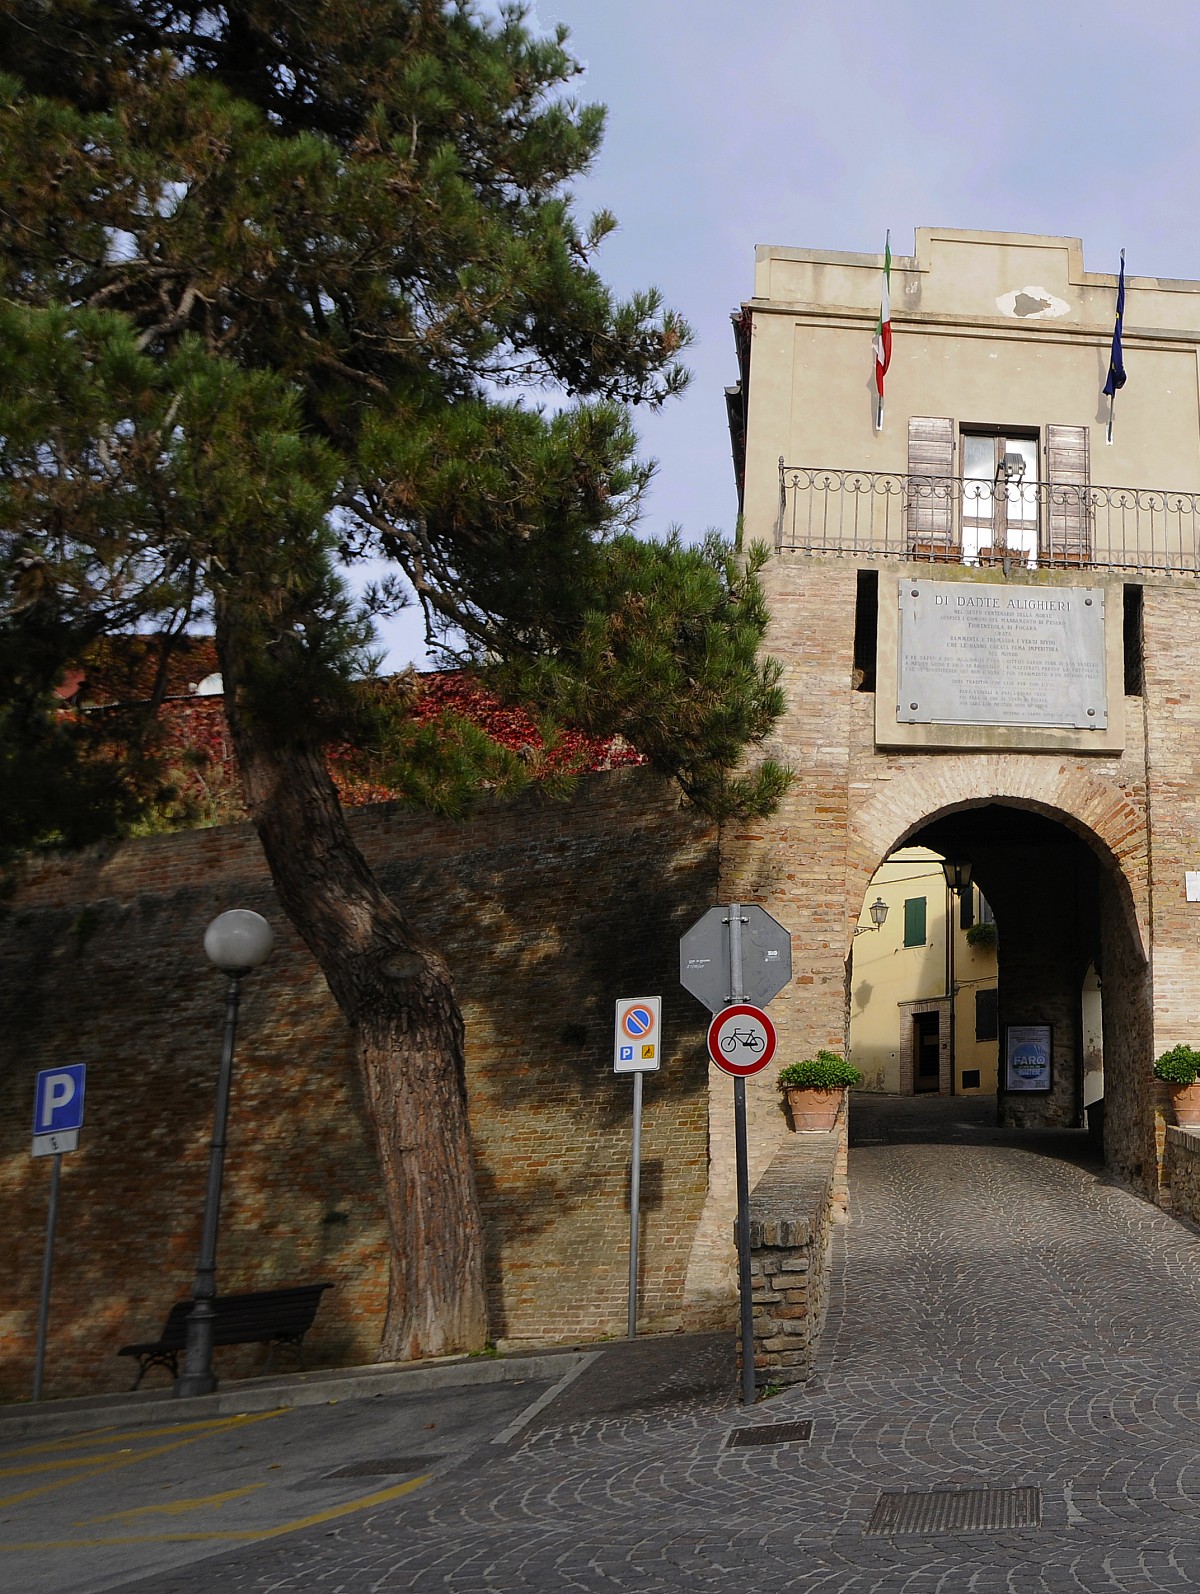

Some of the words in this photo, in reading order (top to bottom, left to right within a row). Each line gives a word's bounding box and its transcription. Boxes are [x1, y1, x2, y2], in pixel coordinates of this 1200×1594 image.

[935, 595, 949, 606] DI
[957, 596, 1000, 609] DANTE
[1006, 599, 1071, 612] ALIGHIERI
[622, 1048, 631, 1059] P
[1014, 1056, 1046, 1066] FARO
[42, 1073, 75, 1127] P
